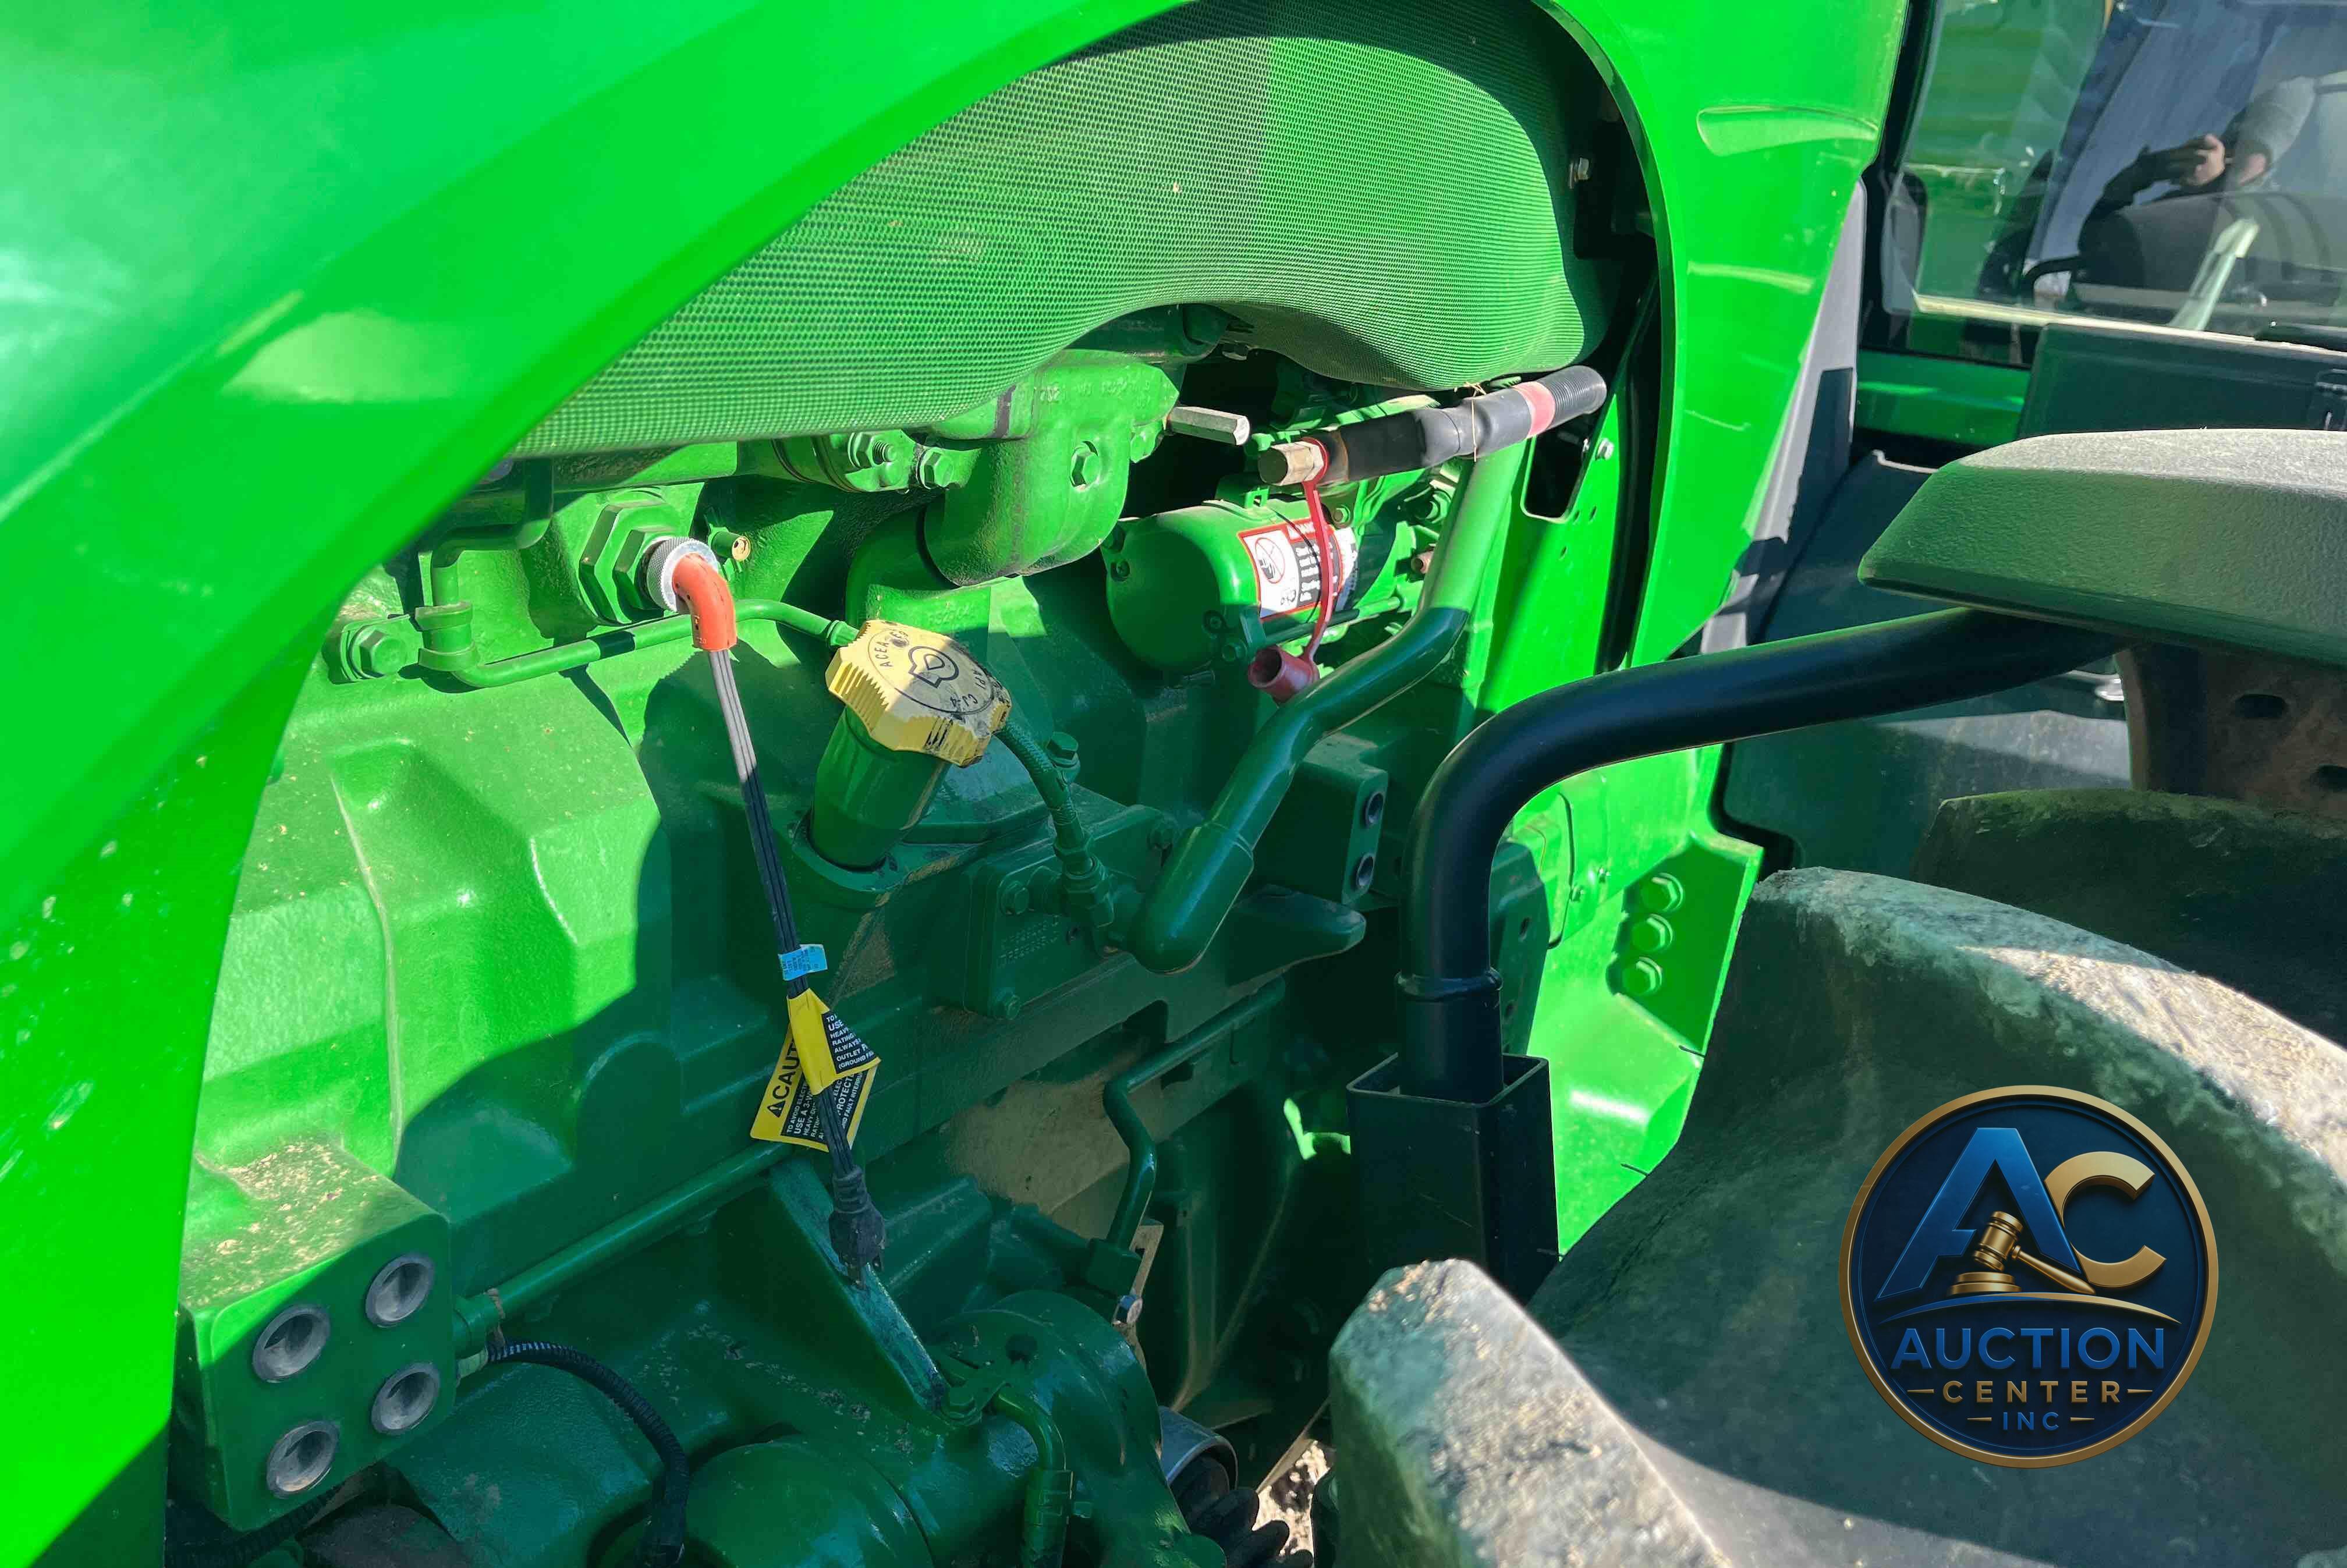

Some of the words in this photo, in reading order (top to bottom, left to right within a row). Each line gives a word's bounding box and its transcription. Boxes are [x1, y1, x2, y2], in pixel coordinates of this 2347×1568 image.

[973, 669, 987, 690] API
[950, 693, 978, 708] CJ-4
[836, 1048, 860, 1062] OUTLET
[772, 1040, 800, 1099] CAUT
[843, 1098, 854, 1117] FAULT
[850, 1072, 862, 1098] INTERRU
[787, 1124, 793, 1133] TO
[790, 1105, 800, 1123] AVOID
[793, 1118, 805, 1134] USE
